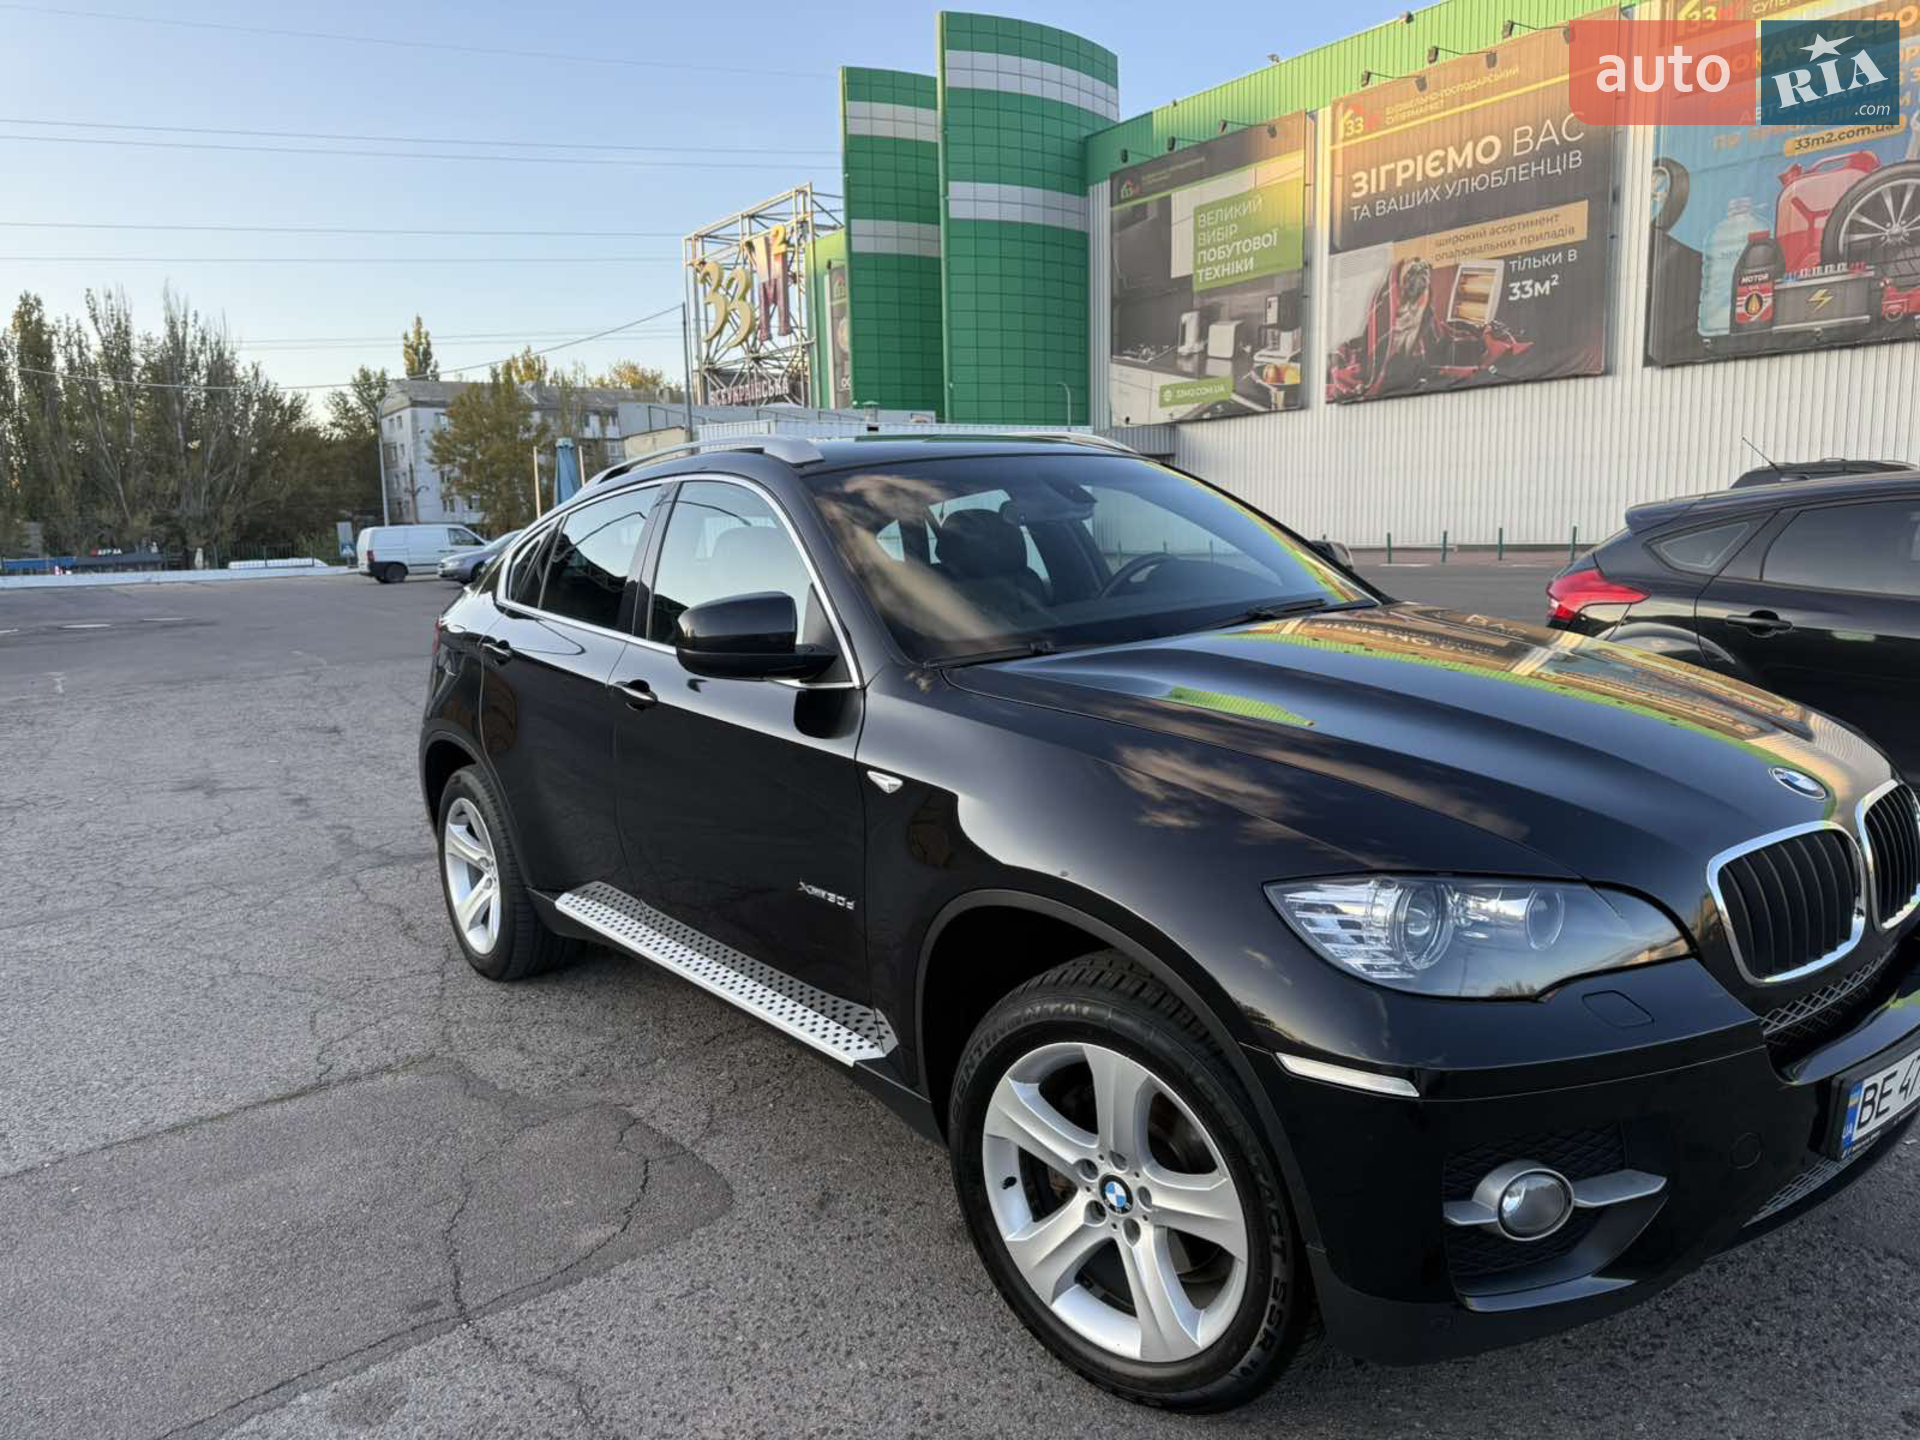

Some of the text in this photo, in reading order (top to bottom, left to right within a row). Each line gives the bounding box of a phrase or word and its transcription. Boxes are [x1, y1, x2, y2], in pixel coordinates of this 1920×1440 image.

[1351, 111, 1586, 199] ЗІГРІЄМО ВАС
[1351, 149, 1583, 222] ТА ВАШИХ УЛЮБЛЕНЦІВ
[1198, 195, 1263, 229] ВЕЛИКИЙ
[1197, 228, 1279, 265] ПОБУТОВОЇ
[1198, 223, 1239, 248] ВИБІР
[1196, 256, 1255, 283] ТЕХНІКИ
[1509, 253, 1563, 273] тільки
